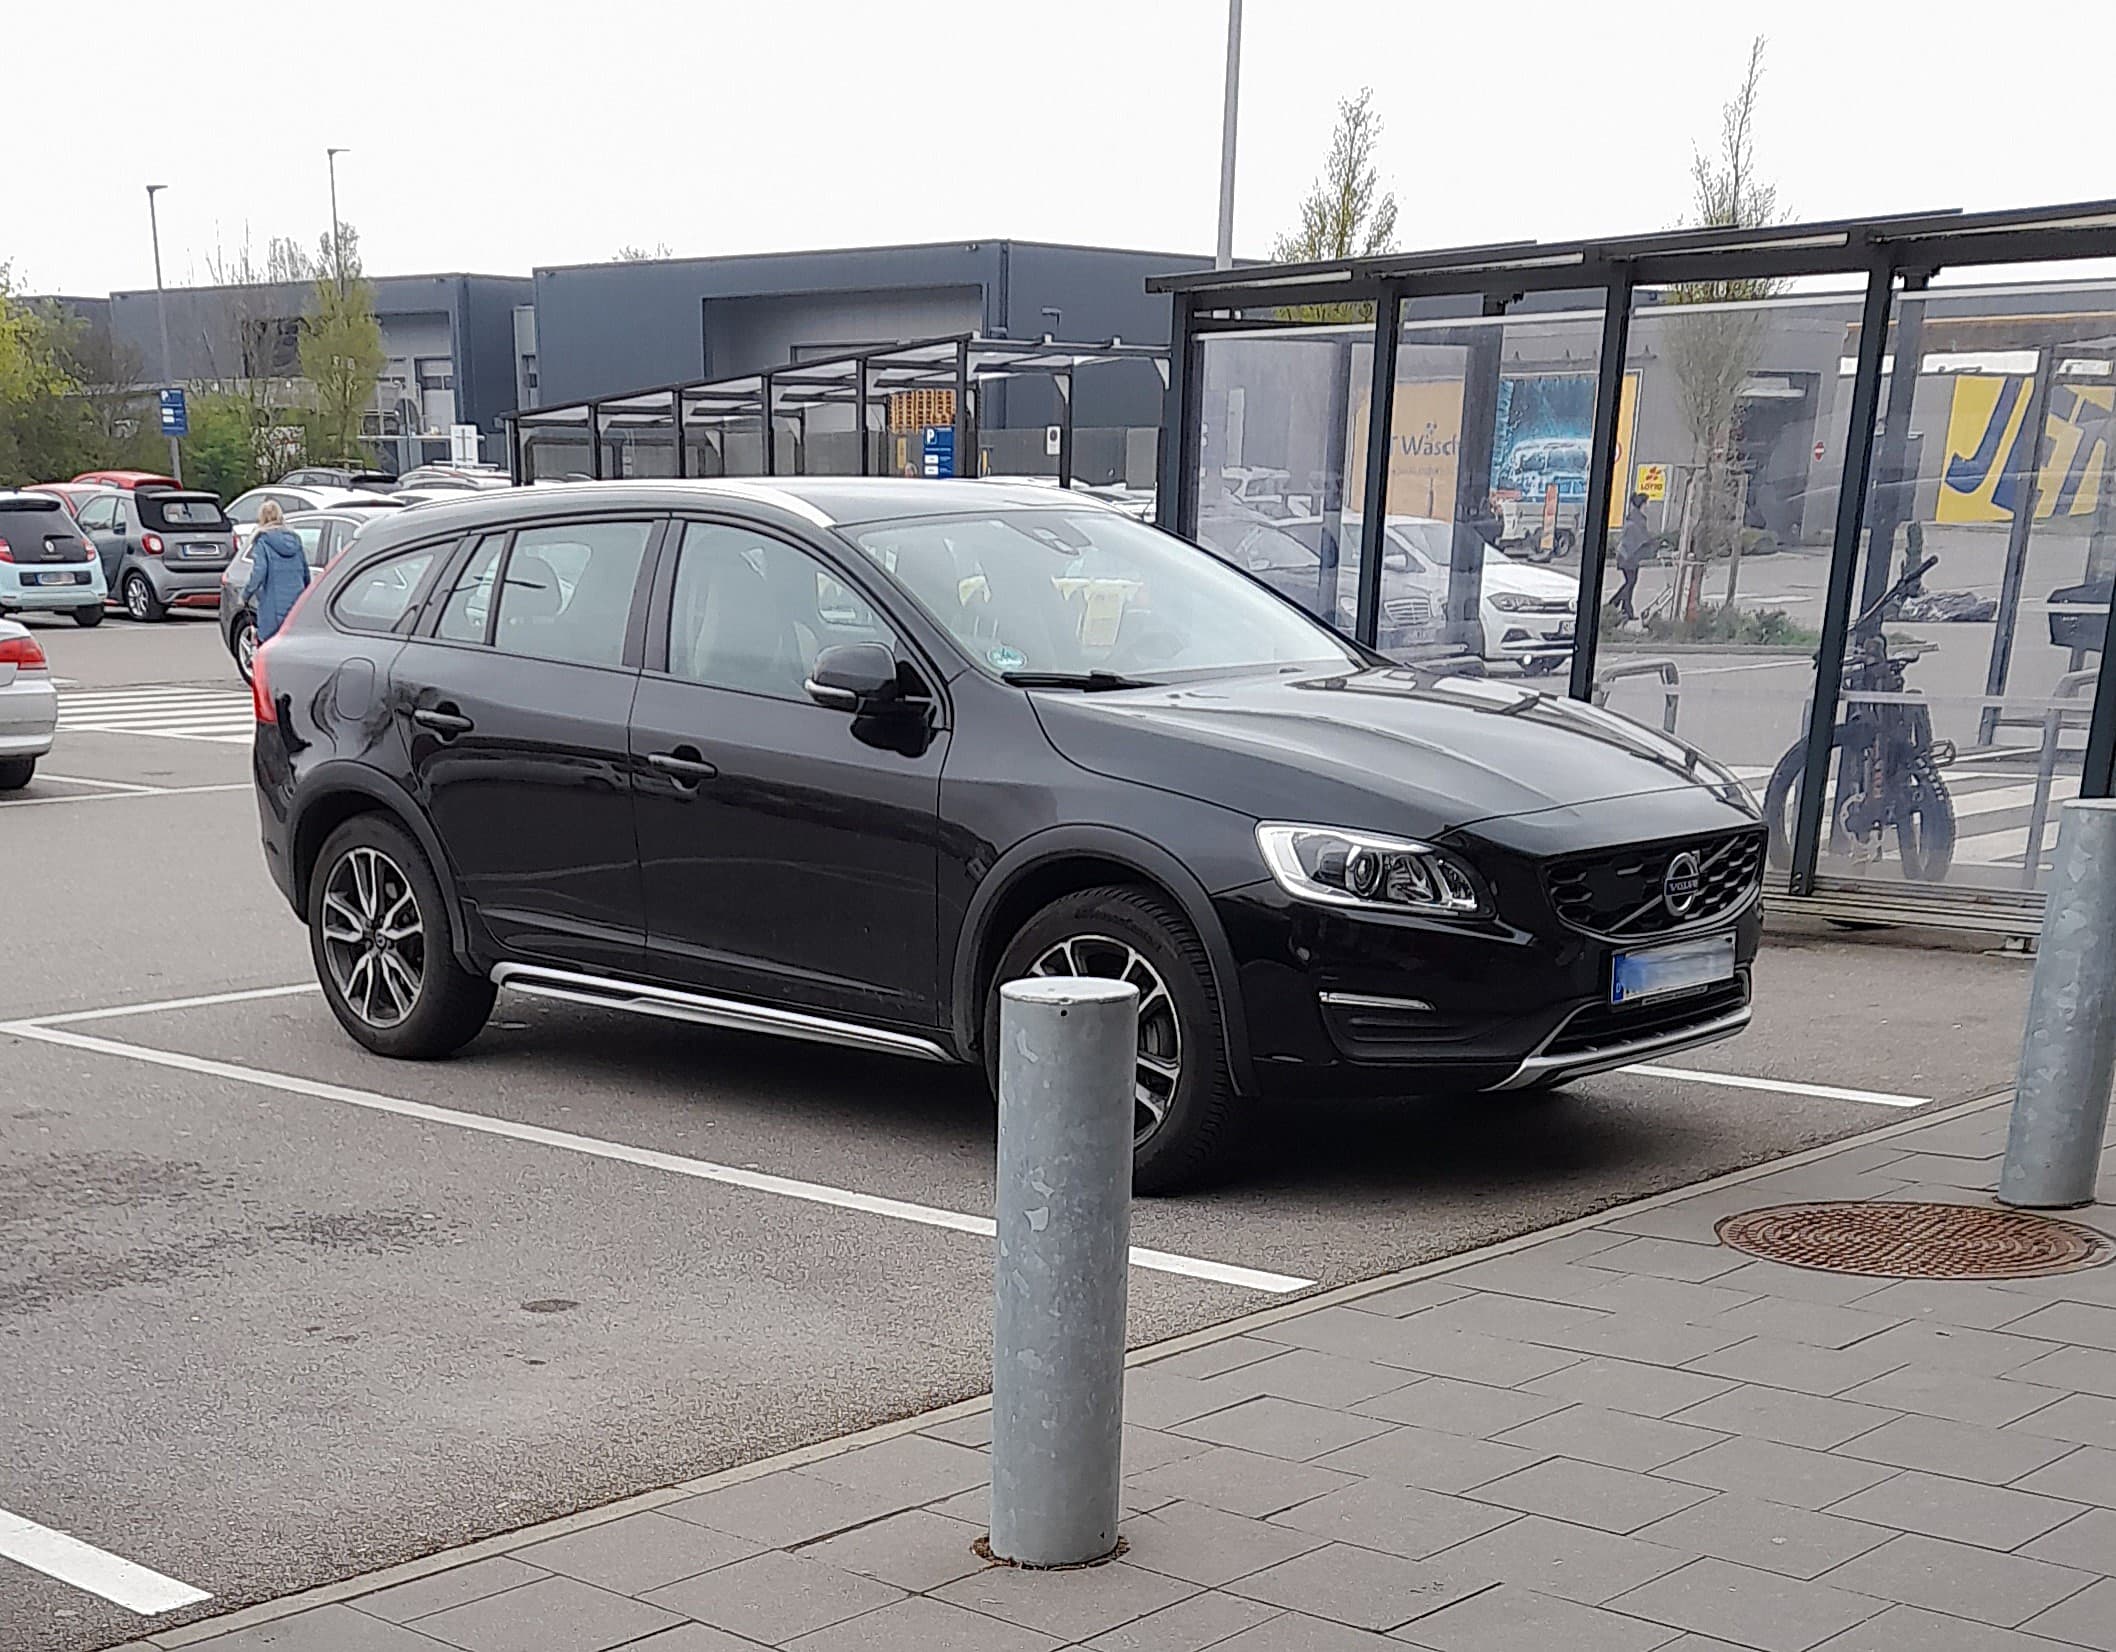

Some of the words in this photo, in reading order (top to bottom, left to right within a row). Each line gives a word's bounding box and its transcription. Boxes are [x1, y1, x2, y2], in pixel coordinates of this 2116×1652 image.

[926, 428, 935, 445] P
[1640, 483, 1663, 491] LOTTO
[1669, 879, 1698, 892] VOLVO
